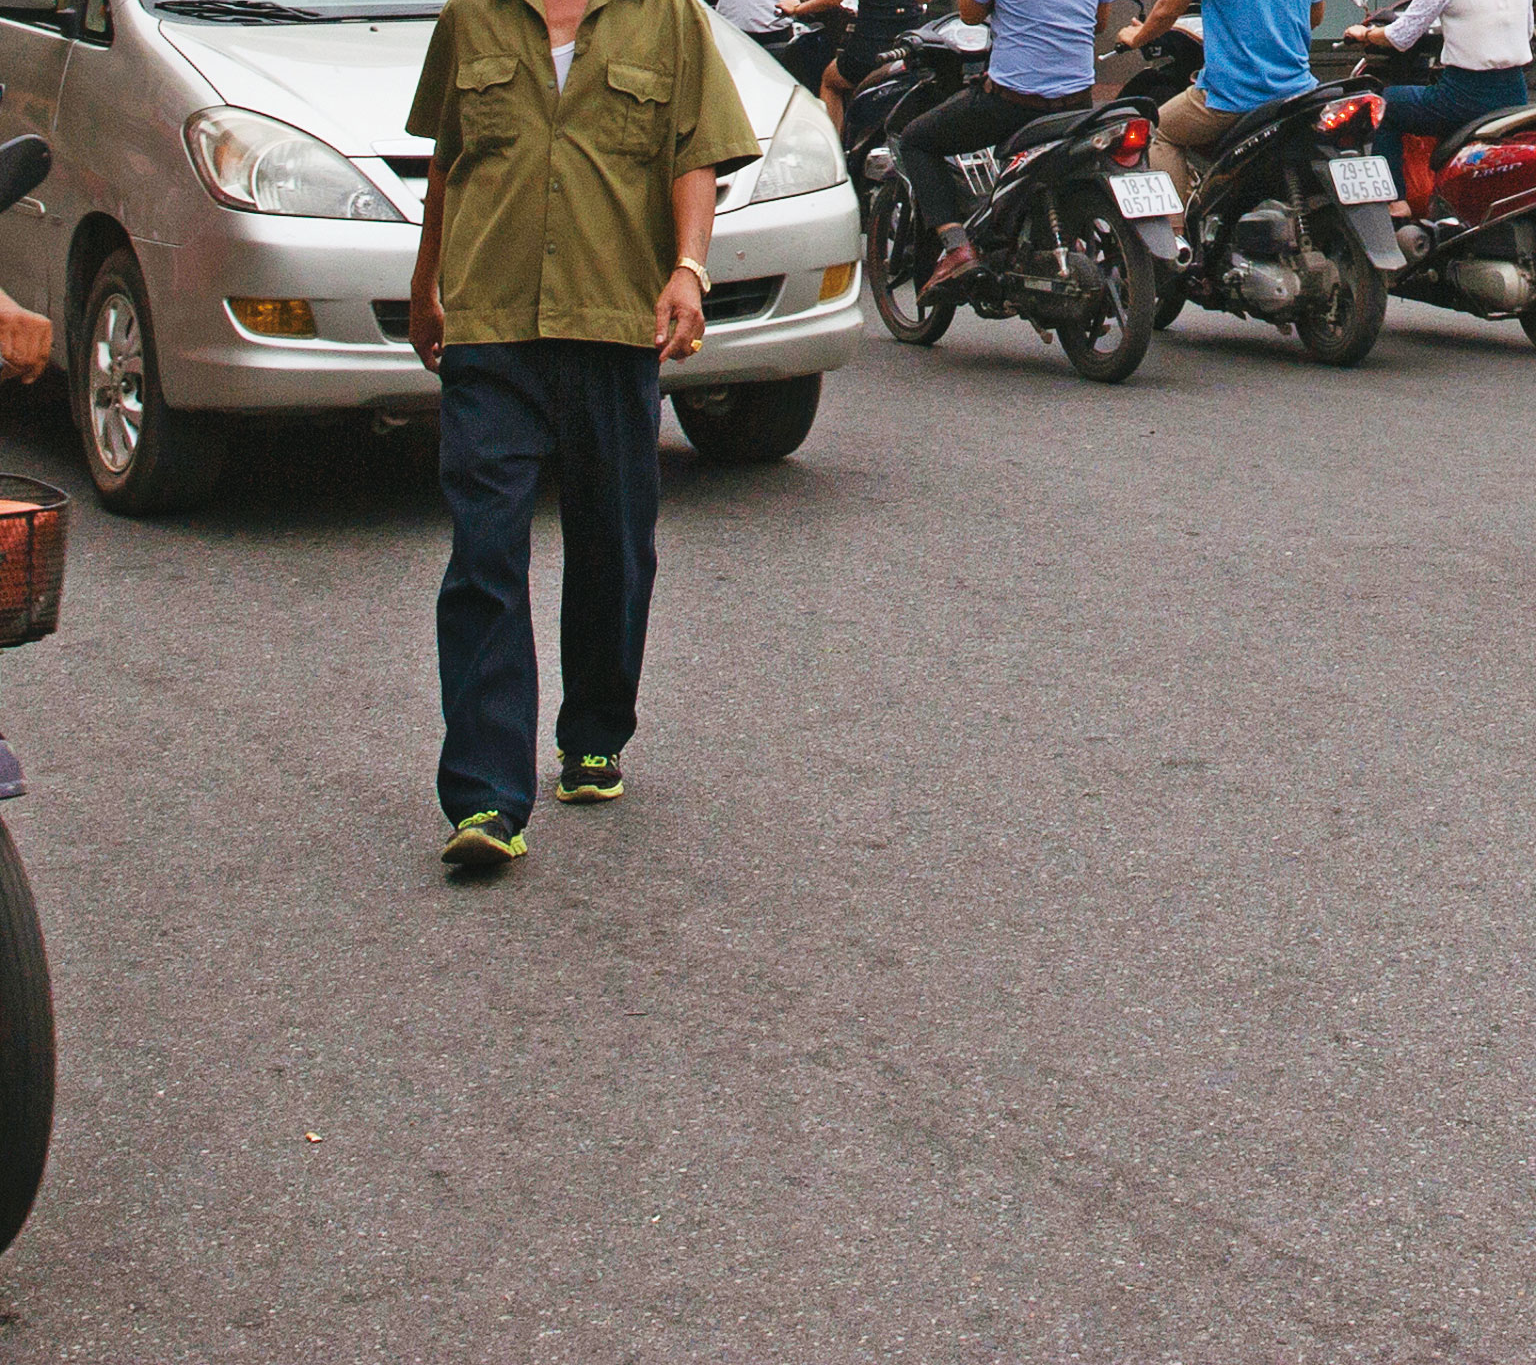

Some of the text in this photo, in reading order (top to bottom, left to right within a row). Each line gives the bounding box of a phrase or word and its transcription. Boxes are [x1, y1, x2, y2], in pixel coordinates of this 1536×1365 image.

[1339, 159, 1382, 180] 29-E1
[1121, 176, 1166, 195] 18-K1
[1340, 179, 1395, 199] 945.69
[1124, 193, 1180, 216] 057.74
